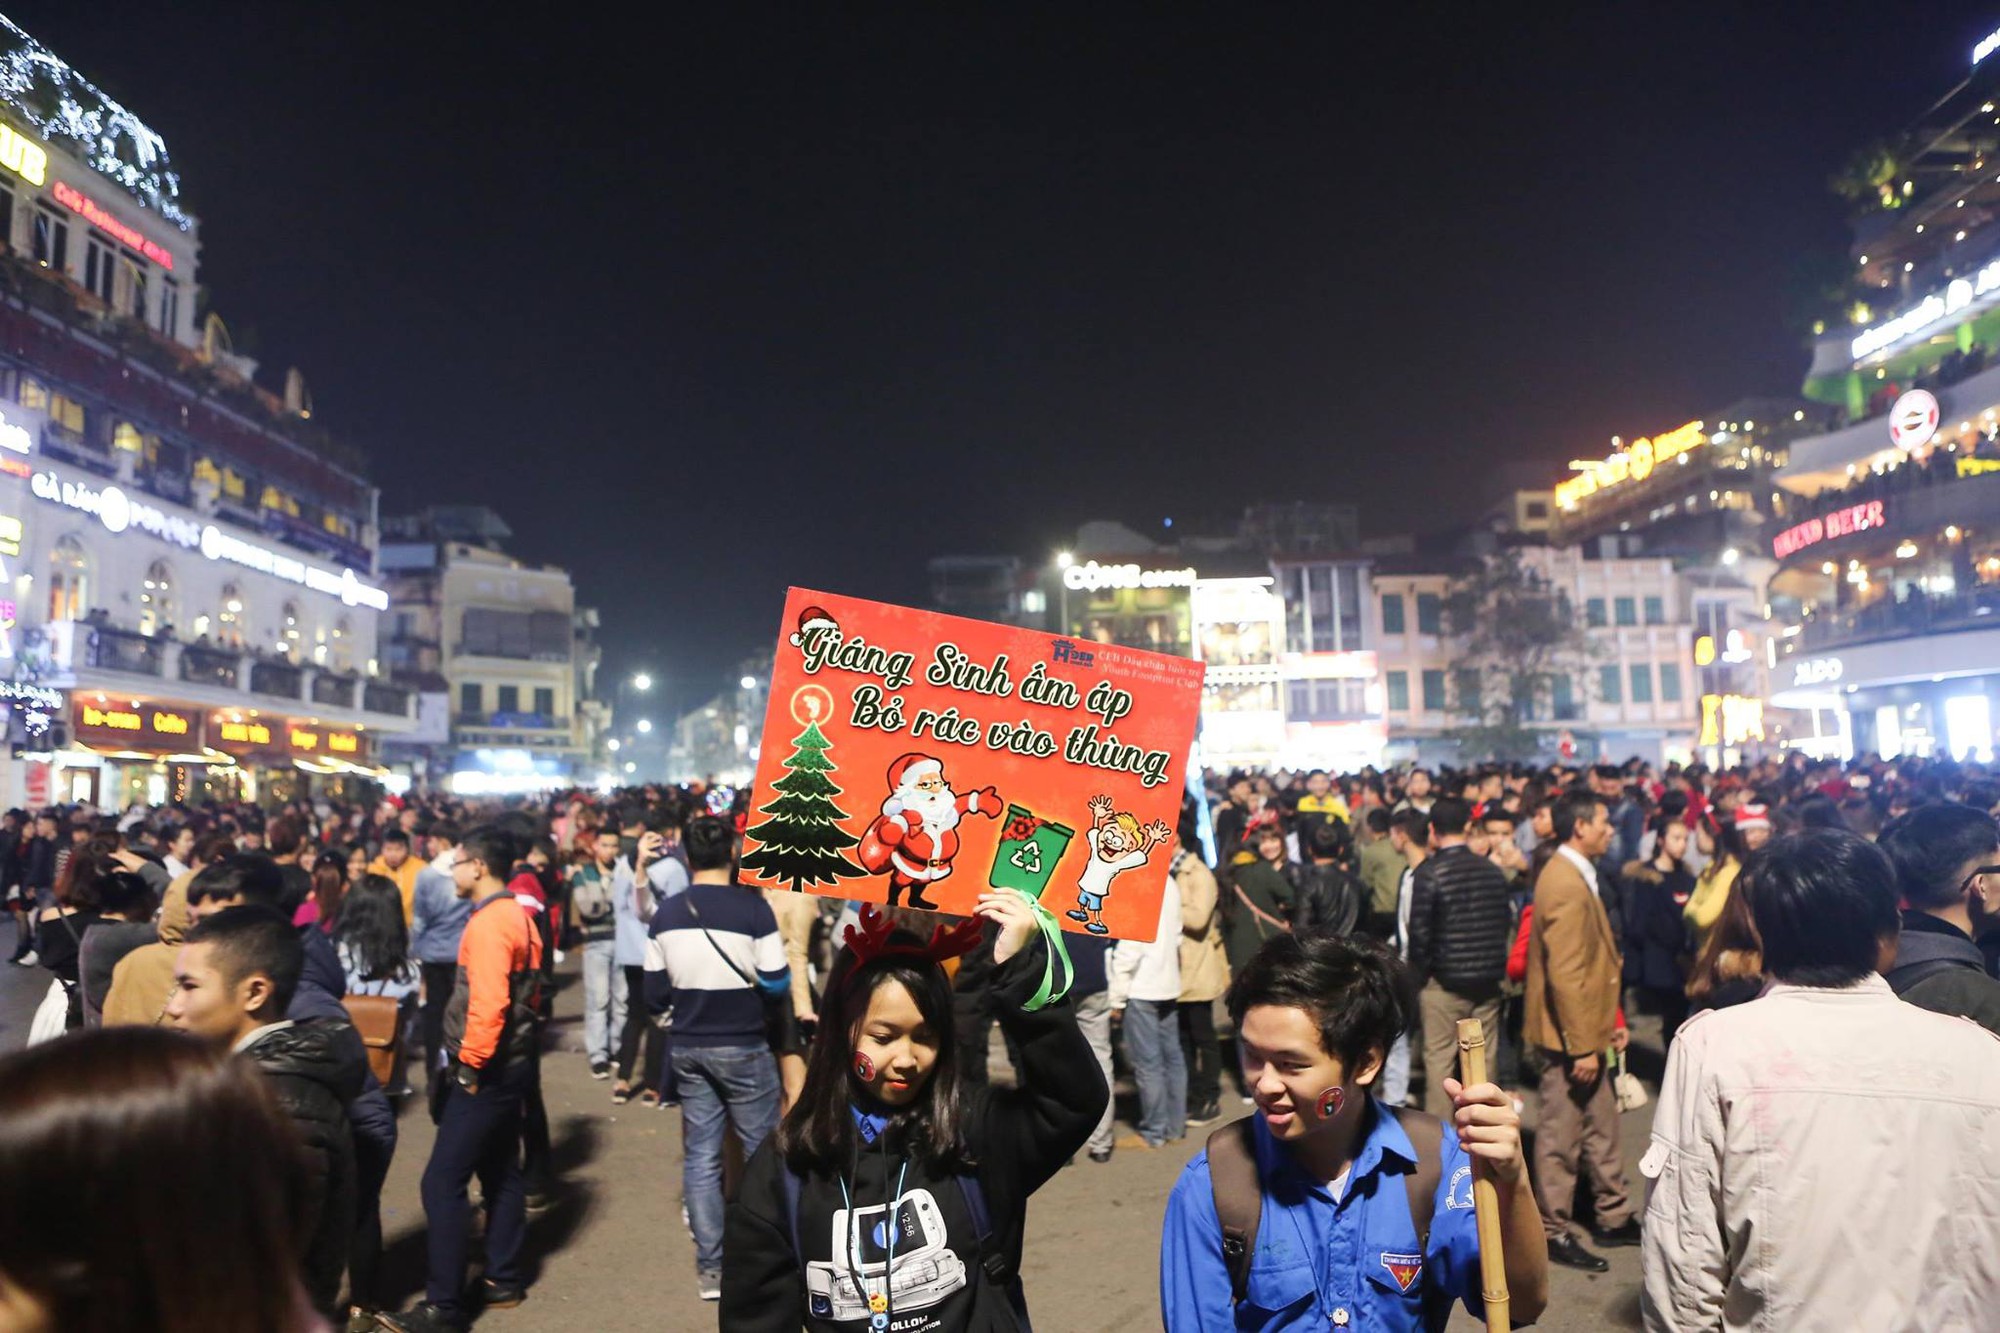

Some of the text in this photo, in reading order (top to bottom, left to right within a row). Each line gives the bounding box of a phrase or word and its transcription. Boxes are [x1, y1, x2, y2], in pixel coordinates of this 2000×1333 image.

[1825, 500, 1886, 539] BEER
[802, 628, 1133, 728] Giáng Sinh ấm áp
[851, 684, 1171, 788] Bỏ rác vào thùng
[901, 1212, 915, 1238] 12:56
